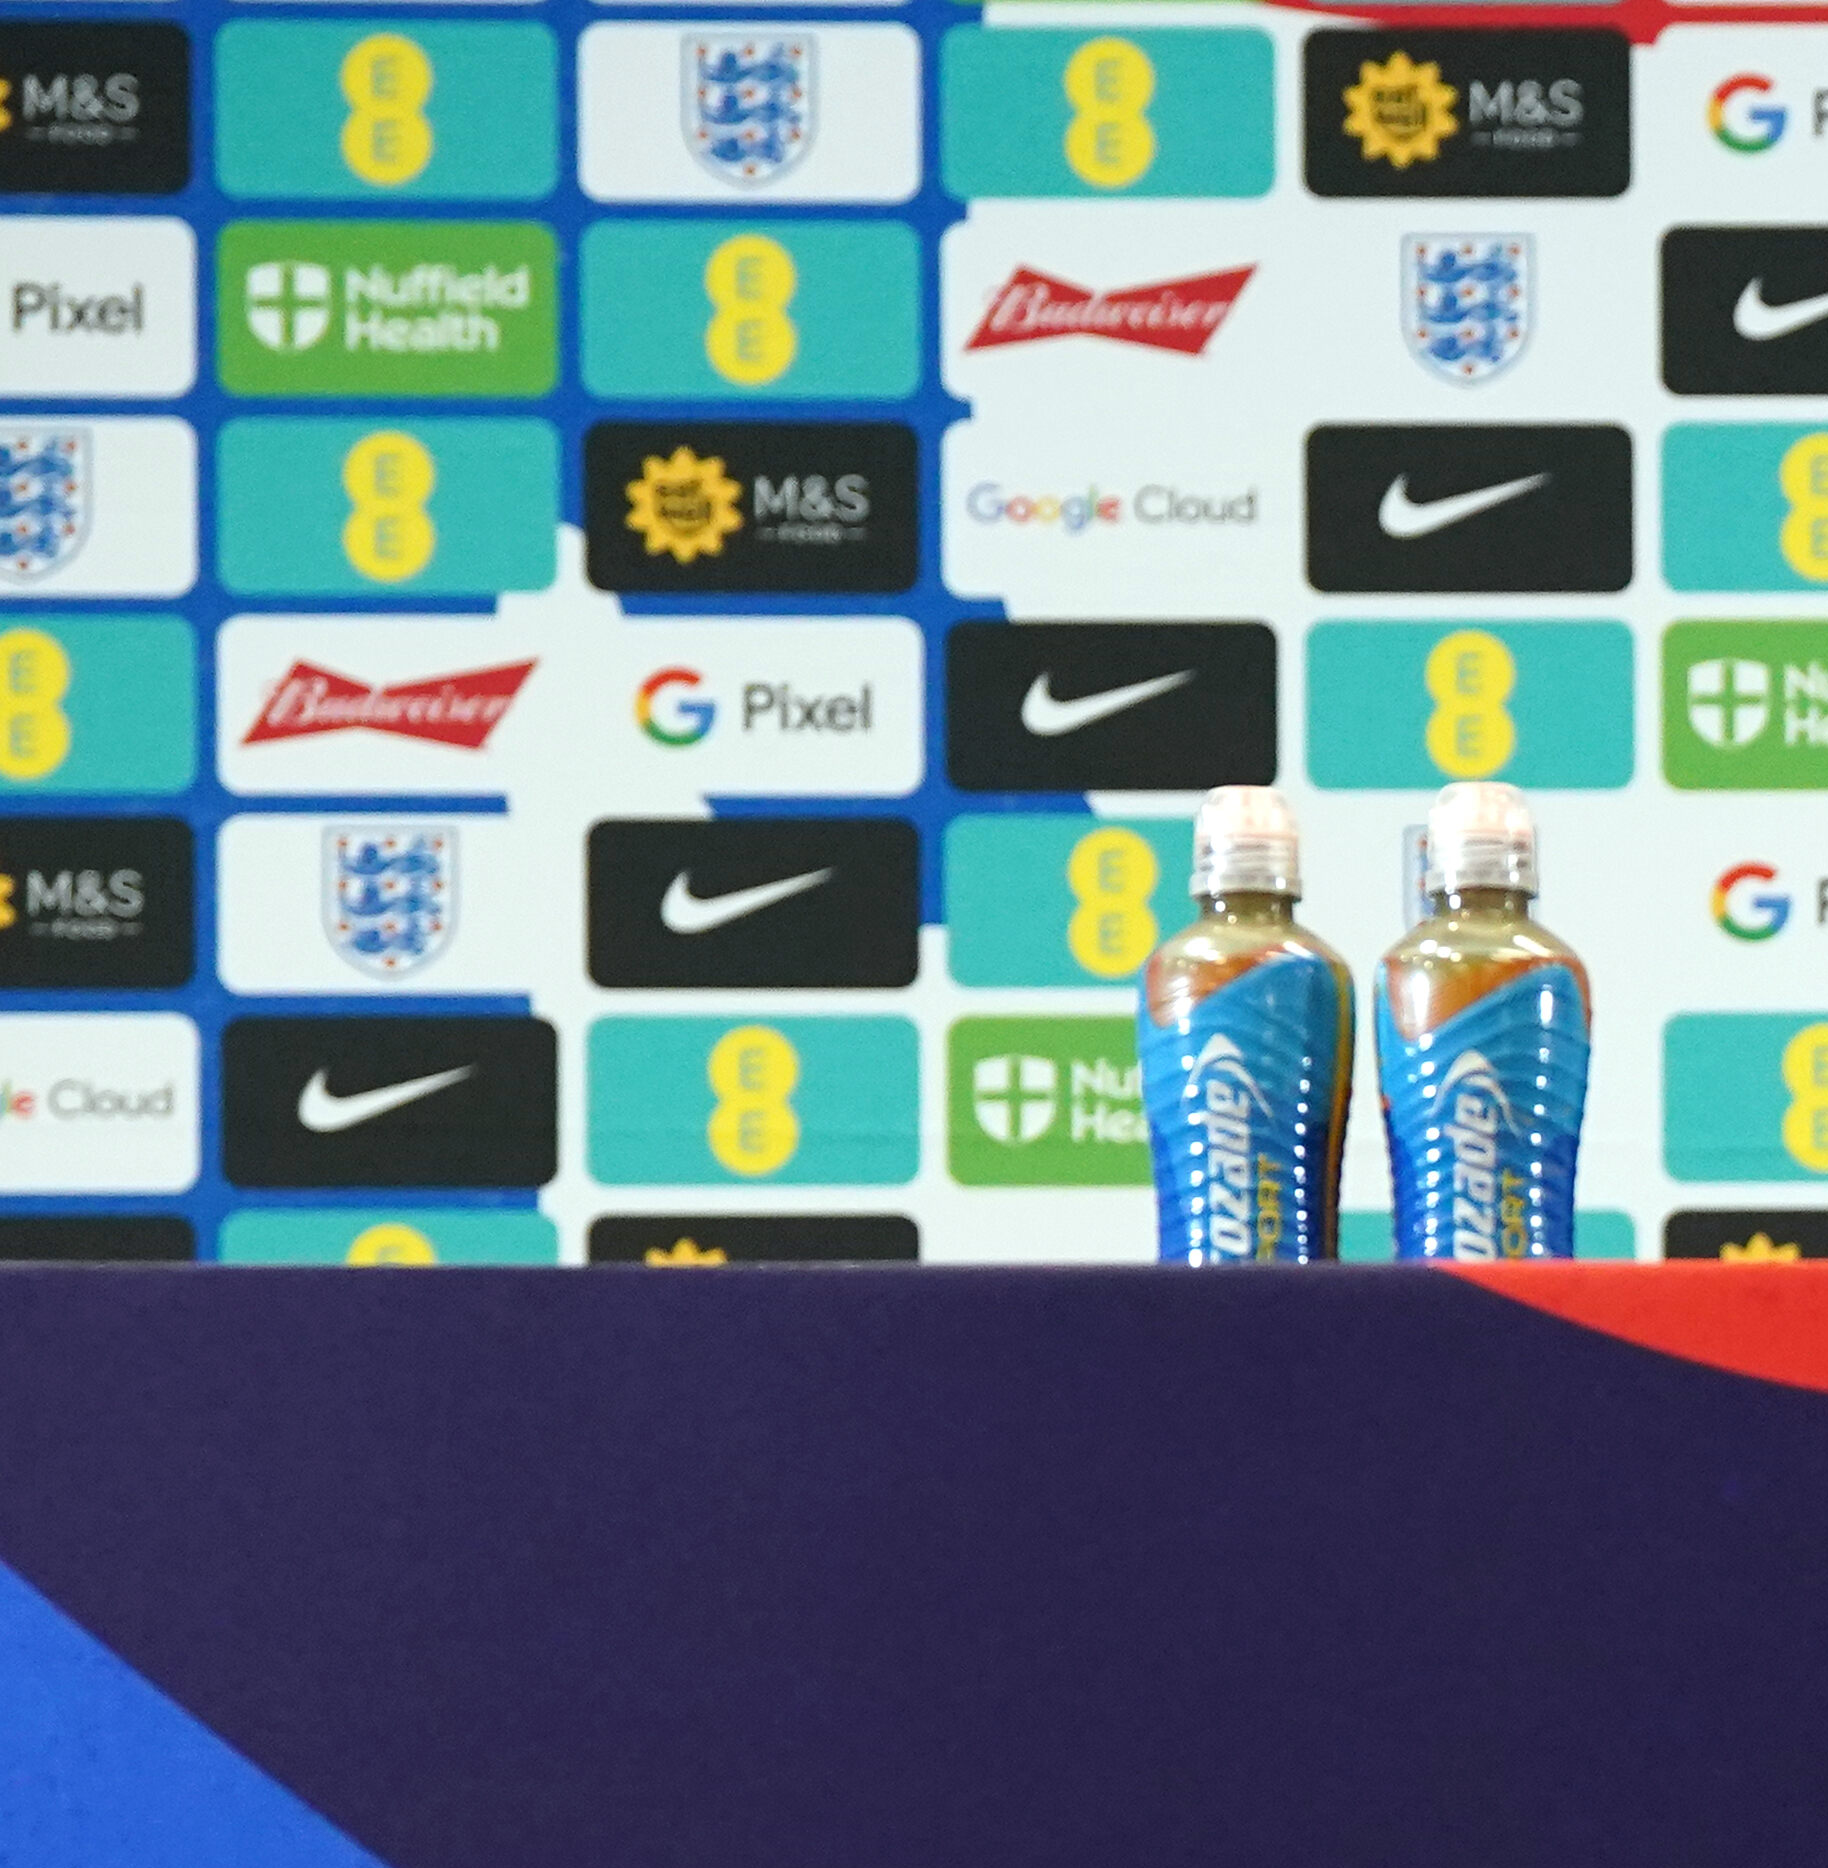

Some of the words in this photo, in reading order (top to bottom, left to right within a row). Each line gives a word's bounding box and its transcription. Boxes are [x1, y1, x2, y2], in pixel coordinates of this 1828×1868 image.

[23, 74, 139, 121] M&S
[1469, 79, 1582, 126] M&S
[12, 282, 144, 334] Pixel
[345, 264, 530, 310] Nuffield
[985, 282, 1230, 332] Budweiser
[345, 310, 499, 352] Health
[754, 474, 868, 521] M&S
[967, 483, 1122, 534] Google
[1133, 484, 1259, 526] Cloud
[264, 675, 514, 727] Budweiser
[742, 683, 872, 733] Pixel
[27, 869, 143, 917] M&S
[47, 1078, 175, 1120] Cloud
[1200, 1078, 1251, 1262] ozade
[1445, 1093, 1500, 1261] ozade
